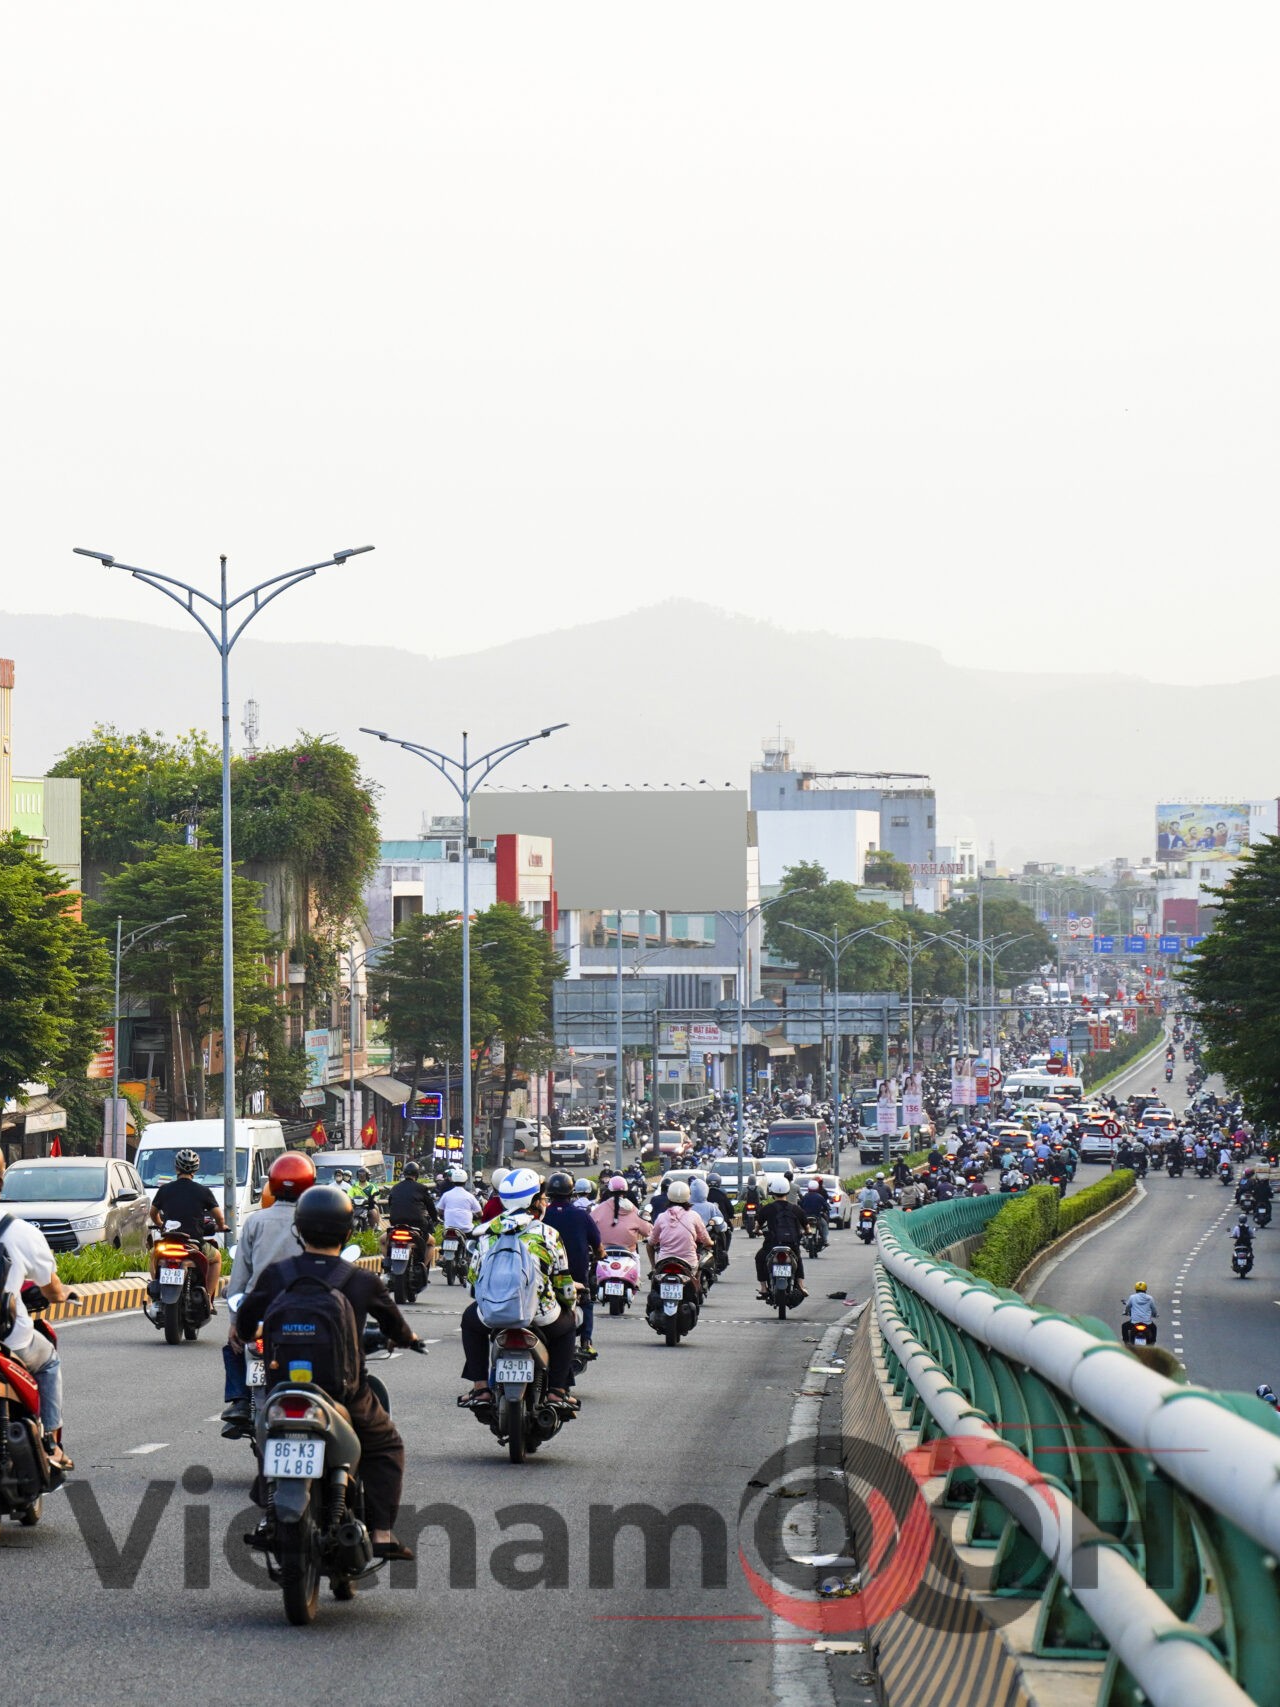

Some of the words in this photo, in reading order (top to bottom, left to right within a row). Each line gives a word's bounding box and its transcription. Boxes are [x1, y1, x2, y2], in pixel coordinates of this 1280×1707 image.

[921, 860, 965, 874] KHÁNH
[282, 1324, 316, 1332] HUTECH
[498, 1370, 532, 1381] 017.76
[274, 1442, 315, 1458] 86-K3
[274, 1460, 314, 1475] 1486
